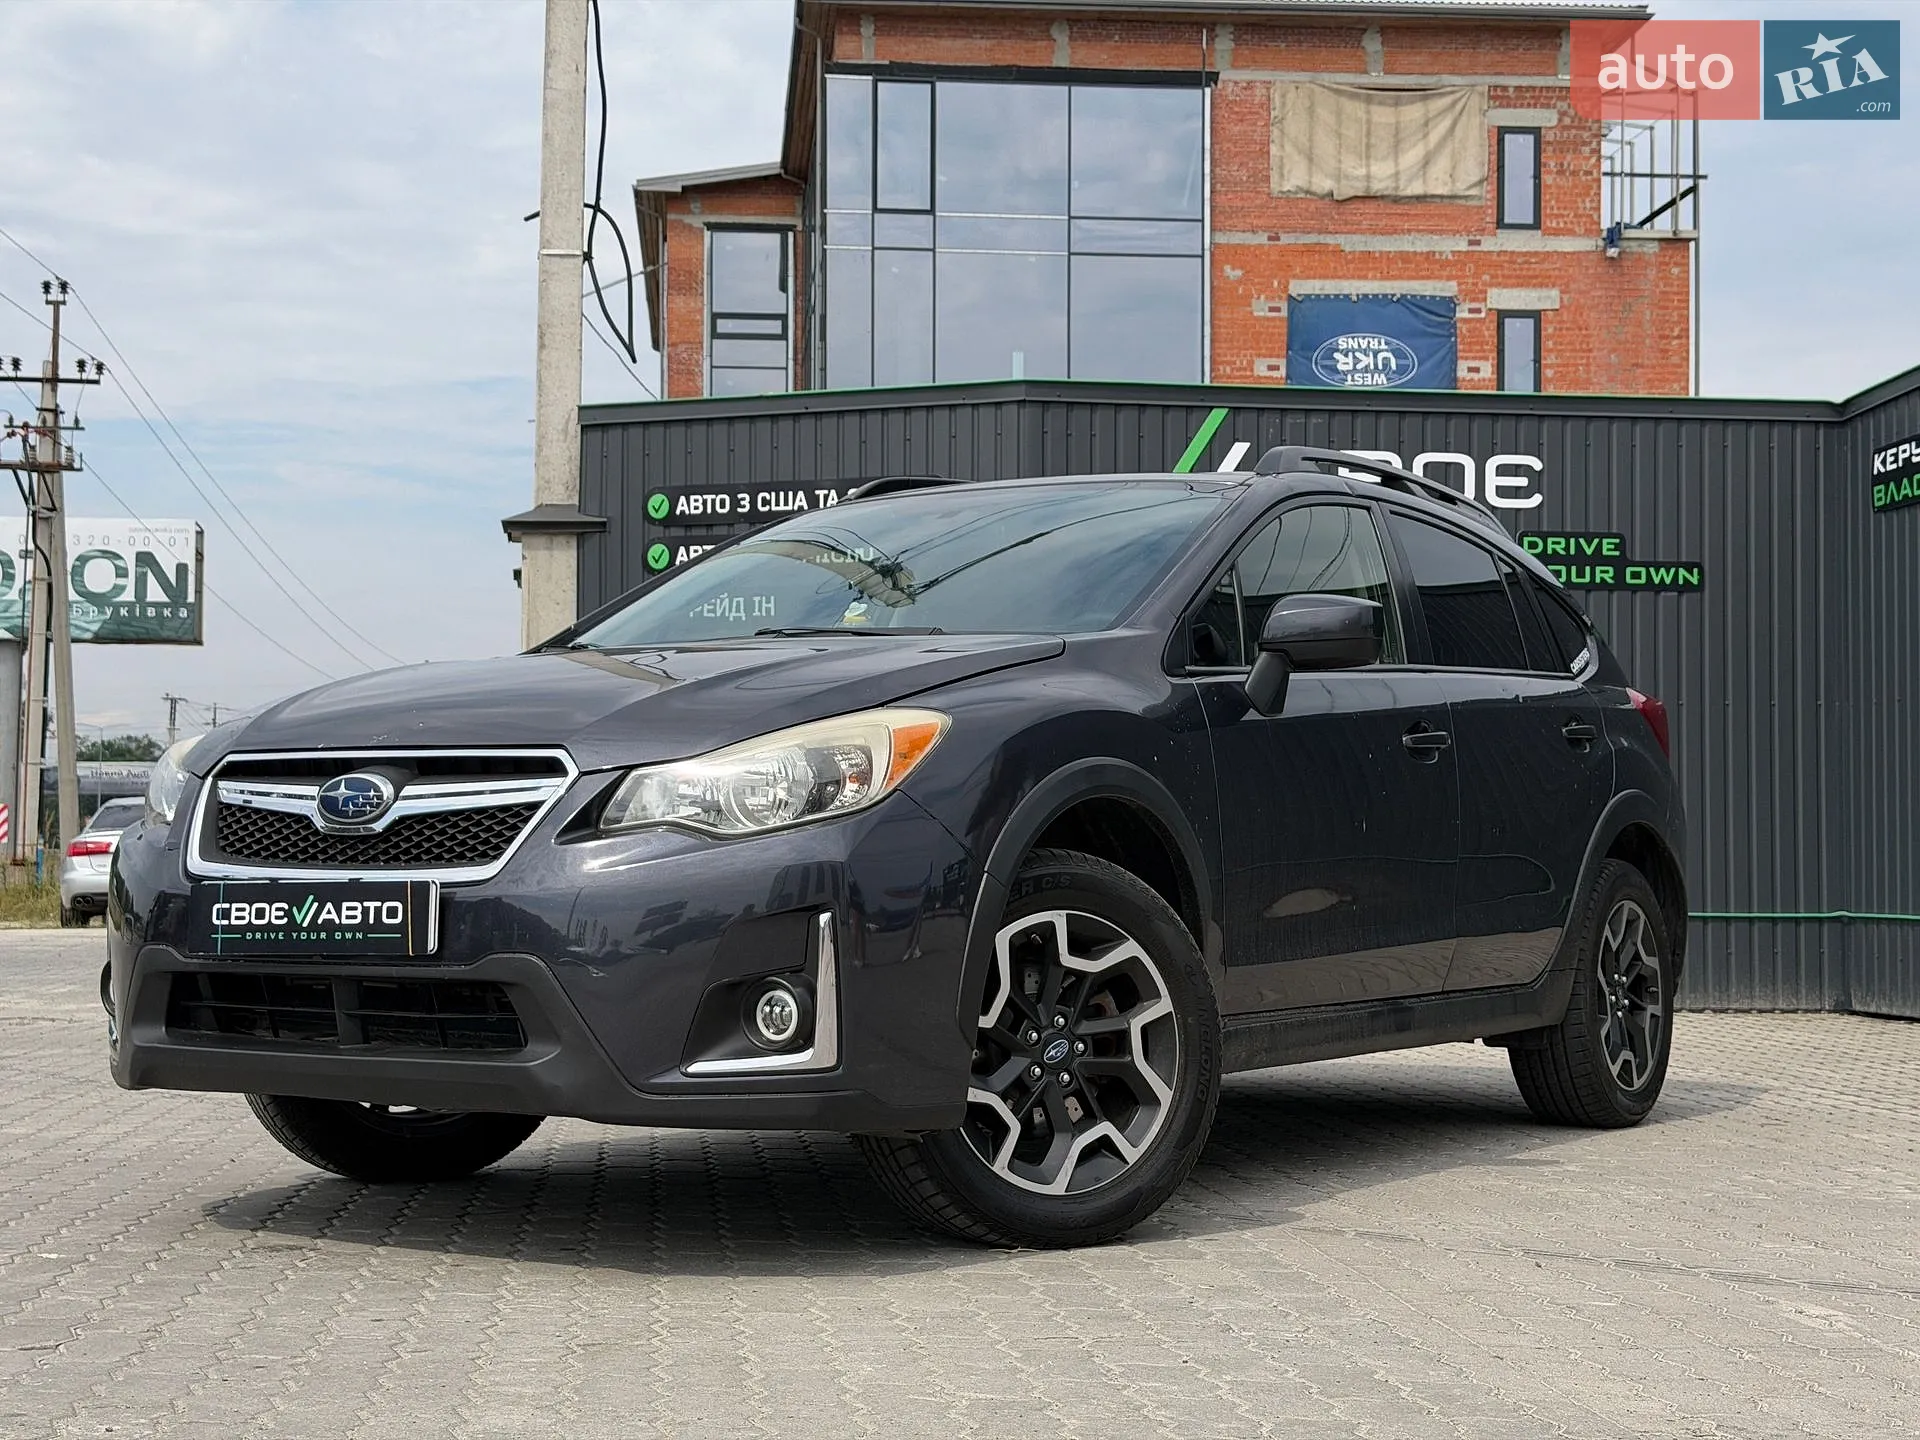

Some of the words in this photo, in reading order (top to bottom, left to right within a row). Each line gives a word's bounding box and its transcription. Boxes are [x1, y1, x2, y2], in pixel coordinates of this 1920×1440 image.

[1337, 336, 1388, 350] TRANS
[1333, 351, 1397, 371] UKR
[1345, 372, 1388, 386] WEST
[675, 493, 730, 516] АВТО
[757, 490, 809, 512] США
[815, 488, 838, 509] ТА
[1523, 536, 1620, 556] DRIVE
[1547, 565, 1615, 584] OUR
[1625, 567, 1700, 585] OWN
[72, 604, 190, 620] Бруківка
[317, 901, 404, 925] АВТО
[245, 931, 285, 940] DRIVE
[292, 931, 327, 940] YOUR
[334, 931, 364, 940] OWN
